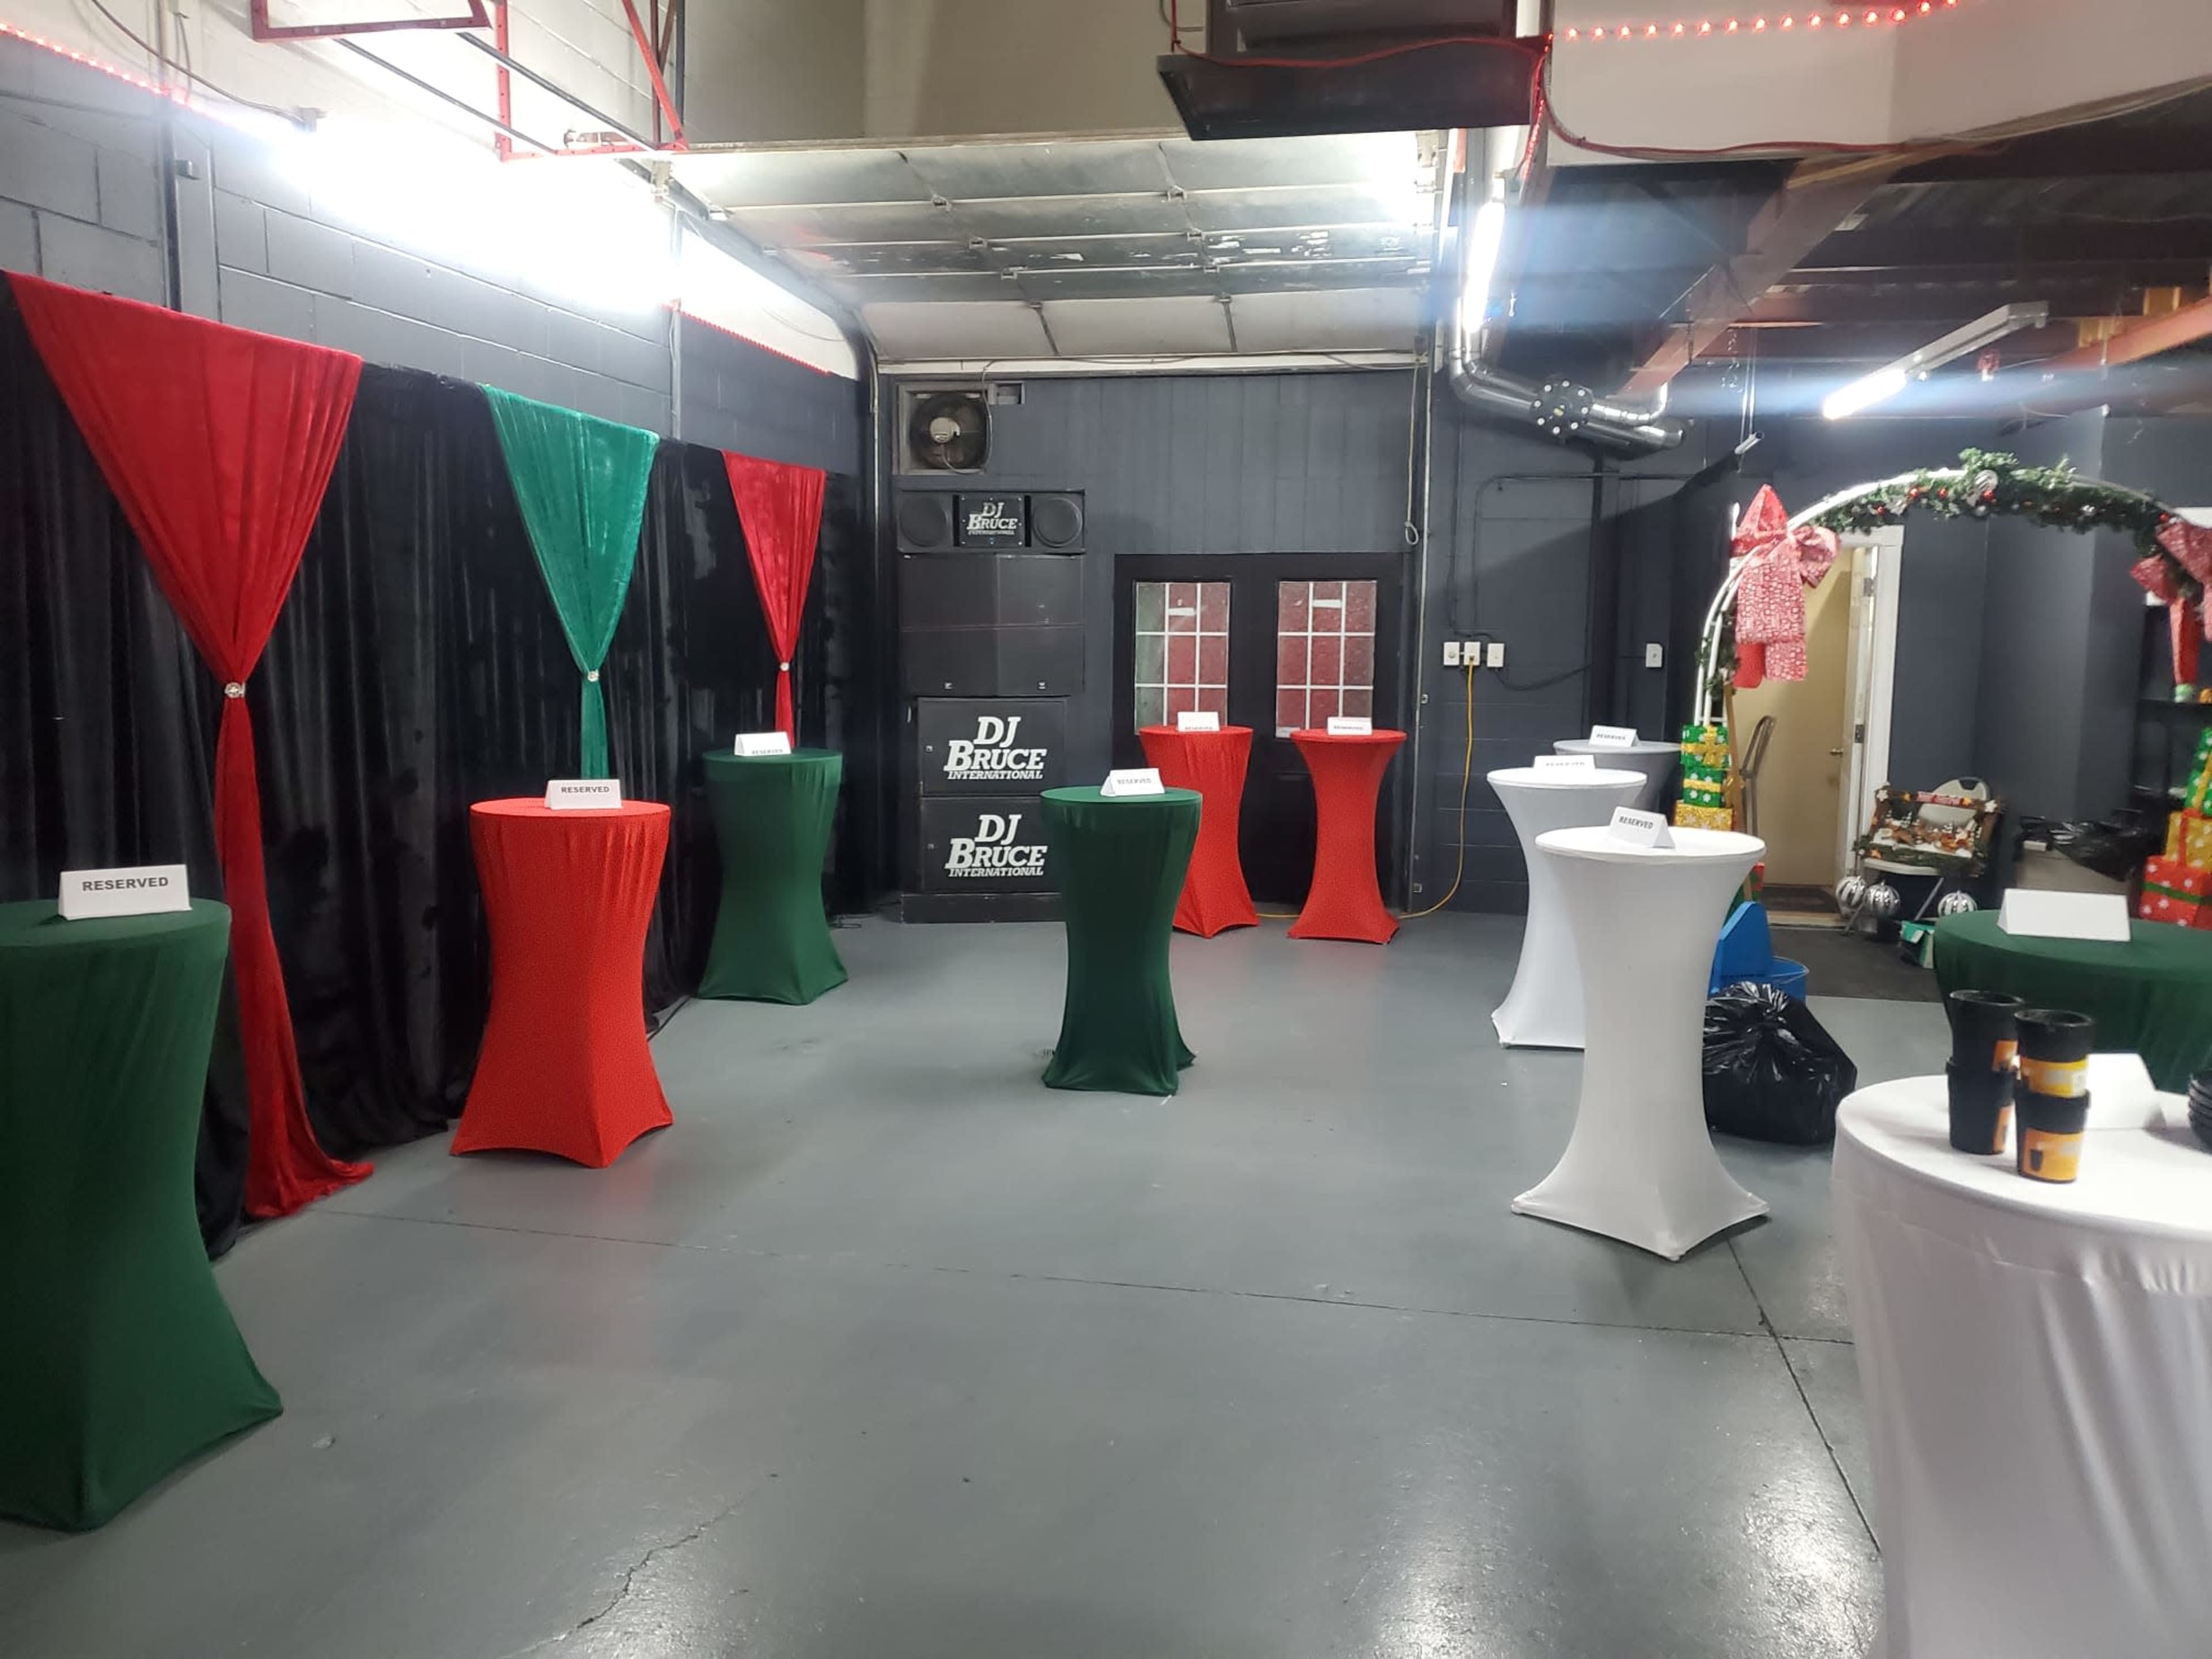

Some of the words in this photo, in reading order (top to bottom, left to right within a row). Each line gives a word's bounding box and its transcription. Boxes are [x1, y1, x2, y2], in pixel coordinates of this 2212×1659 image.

[981, 502, 1005, 518] DJ
[966, 514, 1018, 529] BRUCE
[973, 716, 1021, 748] DJ
[943, 740, 1047, 771] BRUCE
[948, 770, 1043, 779] INTERNATIONAL
[974, 814, 1022, 845] DJ
[1619, 816, 1654, 830] RESERVED
[944, 838, 1048, 869] BRUCE
[948, 867, 1044, 877] INTERNATIONAL
[82, 877, 169, 892] RESERVED
